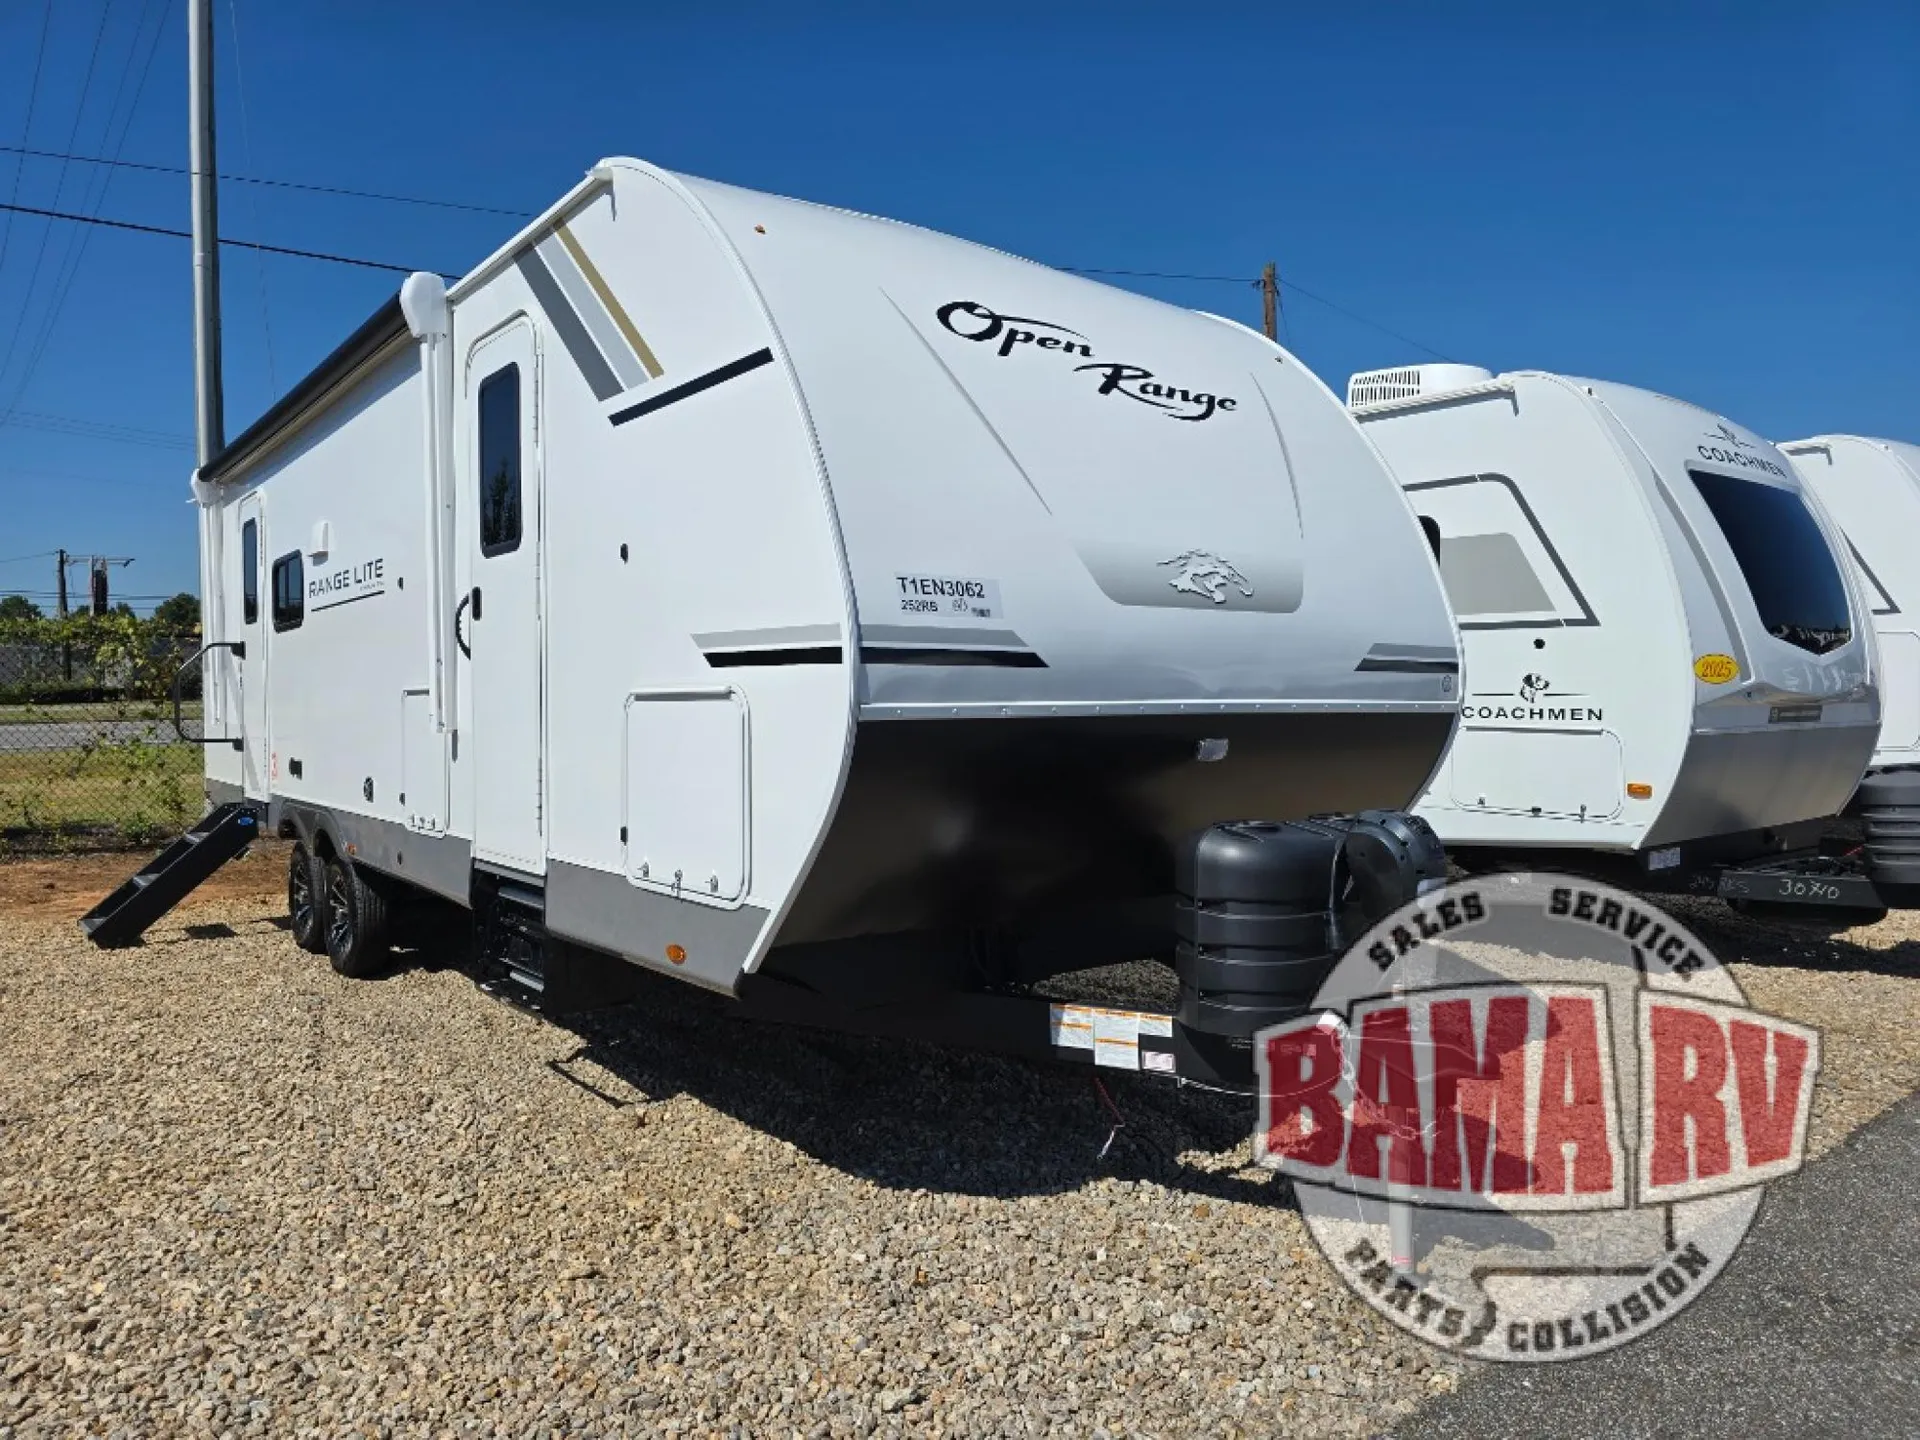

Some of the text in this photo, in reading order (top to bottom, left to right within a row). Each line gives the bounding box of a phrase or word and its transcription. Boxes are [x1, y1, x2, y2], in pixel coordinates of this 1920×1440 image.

[935, 300, 1093, 357] Open
[1073, 362, 1238, 421] Range
[1697, 445, 1788, 479] COACHMEN
[308, 558, 384, 598] RANGE LITE
[896, 576, 985, 599] T1EN3062
[1702, 659, 1733, 679] 2025
[1461, 705, 1602, 721] COACHMEN
